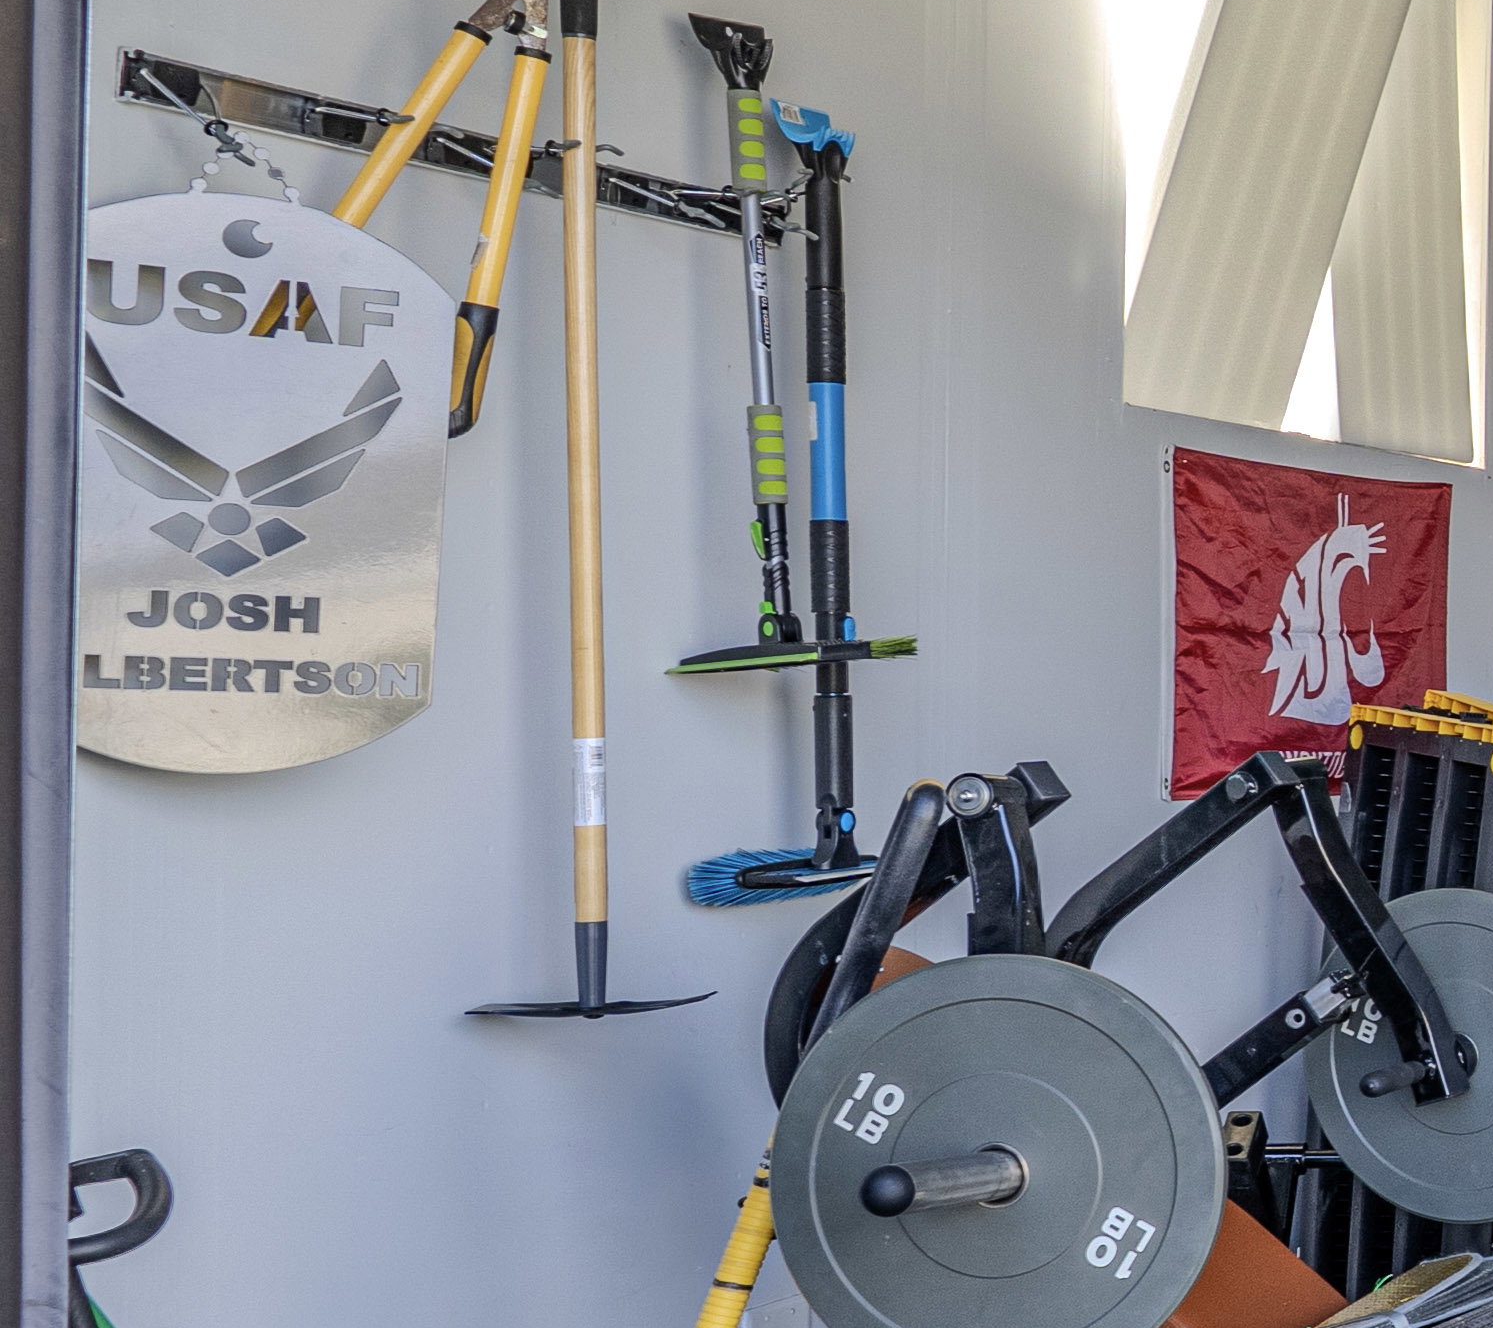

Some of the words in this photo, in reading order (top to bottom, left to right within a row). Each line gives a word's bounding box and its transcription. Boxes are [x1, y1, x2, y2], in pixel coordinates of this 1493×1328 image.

[86, 257, 400, 348] USAF
[126, 589, 321, 634] JOSH
[851, 1071, 905, 1116] 10
[833, 1097, 890, 1145] LB
[1101, 1206, 1156, 1253] LB
[1085, 1234, 1138, 1280] 10
